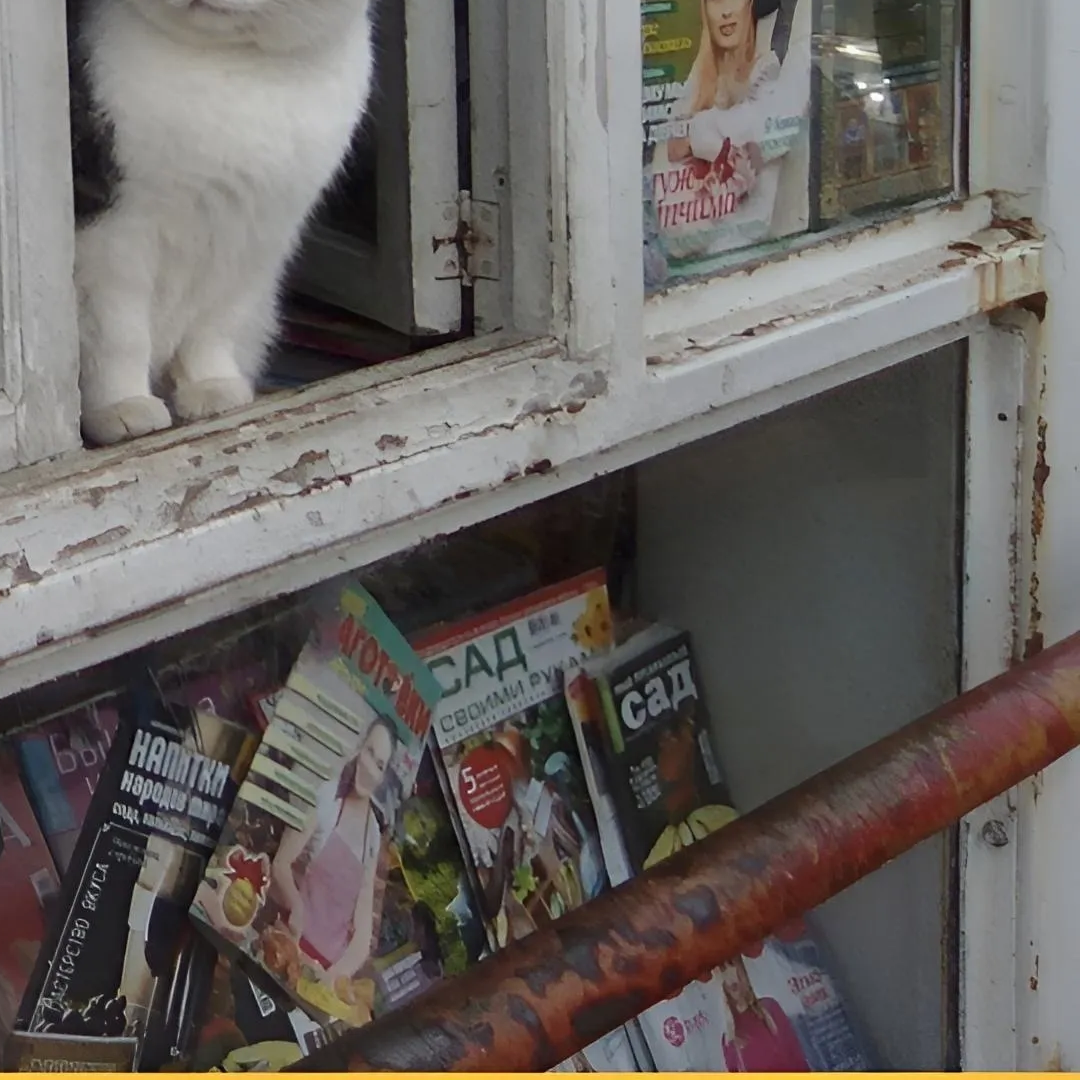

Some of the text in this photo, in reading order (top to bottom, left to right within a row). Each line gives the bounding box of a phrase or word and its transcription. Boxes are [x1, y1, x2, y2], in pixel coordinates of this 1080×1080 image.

[428, 626, 528, 698] САД
[439, 679, 526, 733] СВОИМИ
[128, 728, 230, 799] НАПИТКИ
[461, 766, 477, 794] 5
